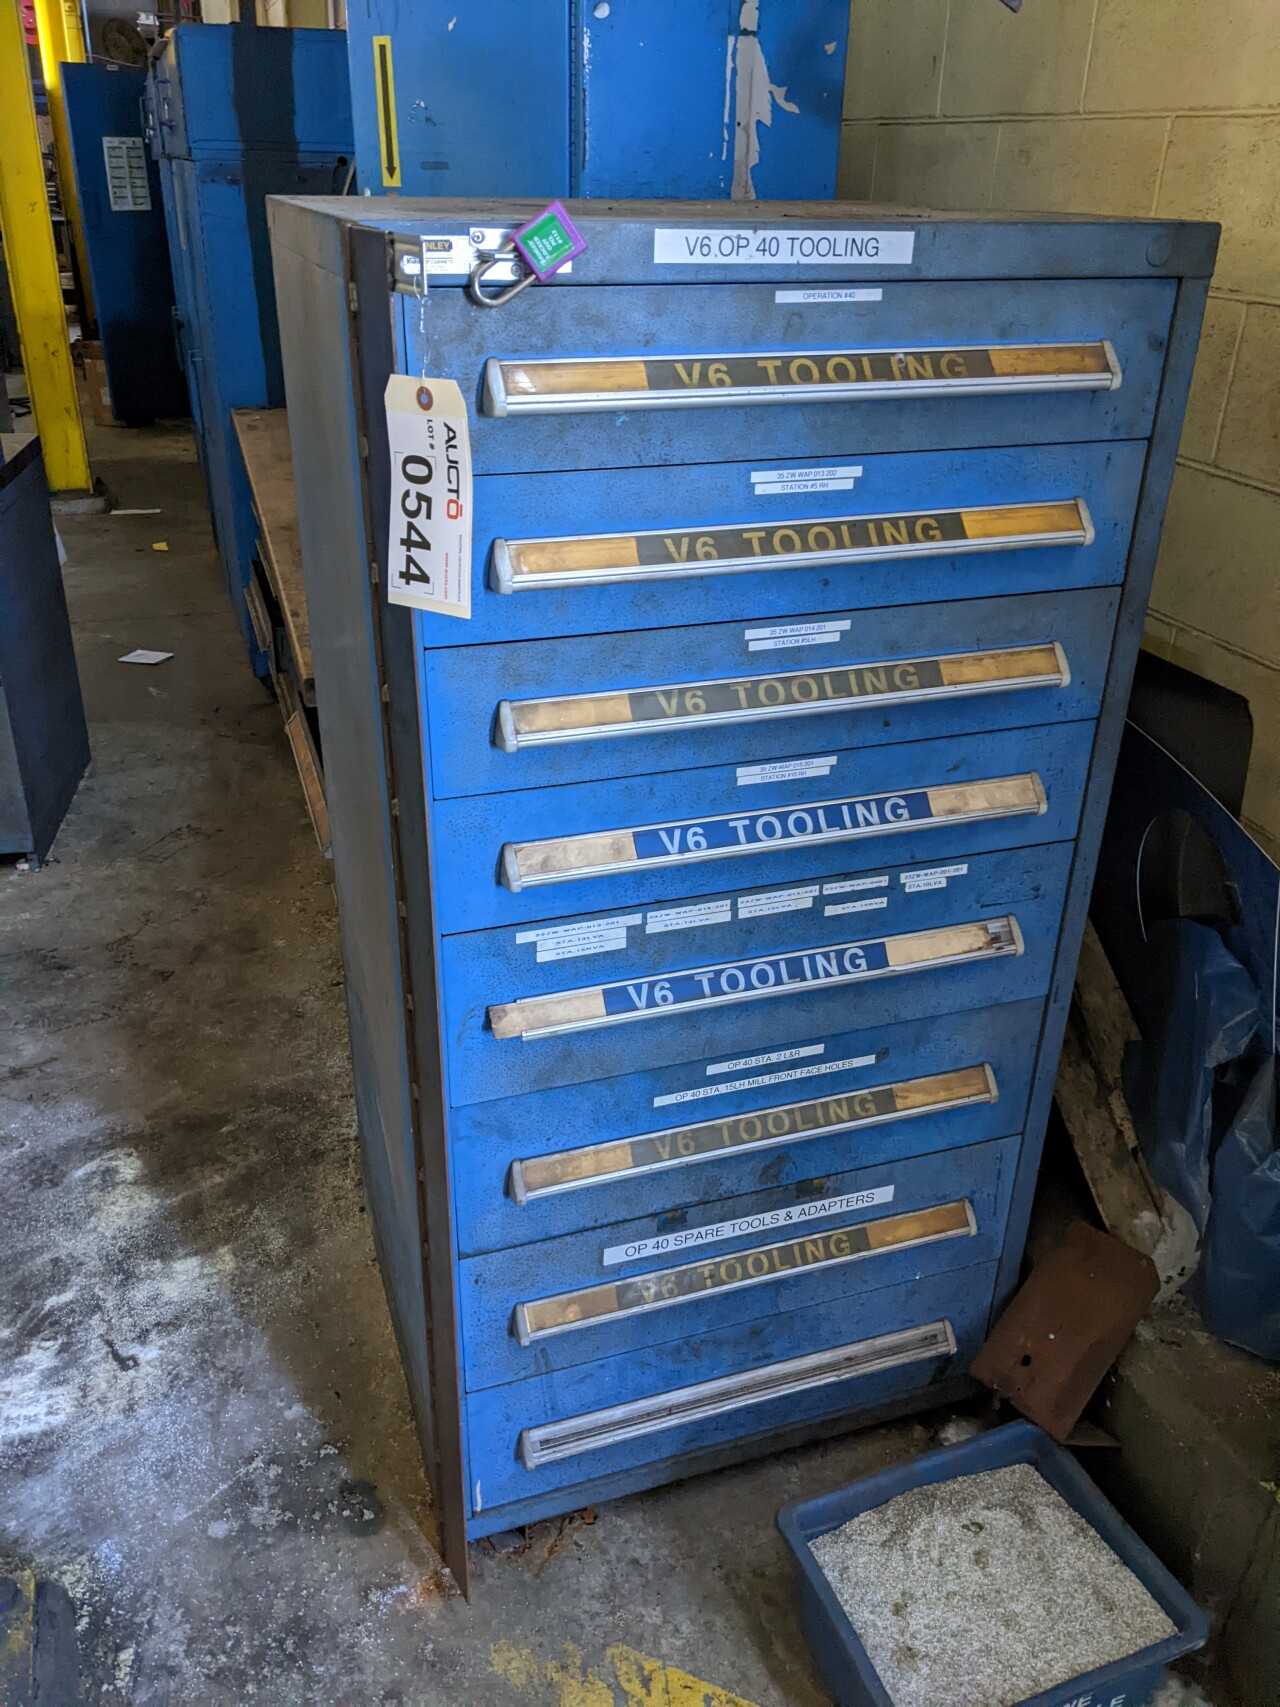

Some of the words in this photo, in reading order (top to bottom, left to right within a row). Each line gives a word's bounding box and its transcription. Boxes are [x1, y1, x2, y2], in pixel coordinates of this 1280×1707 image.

[756, 237, 779, 257] 40
[786, 237, 880, 257] TOOLING
[802, 292, 842, 300] OPERATION
[674, 361, 733, 388] V6
[756, 352, 969, 386] TOOLING
[426, 419, 435, 443] LOT
[798, 470, 813, 479] WAP
[398, 454, 434, 586] 0544
[664, 536, 719, 563] V6
[742, 516, 943, 557] TOOLING
[774, 638, 800, 647] STATION
[656, 688, 707, 716] V6
[729, 664, 921, 710] TOOLING
[658, 826, 708, 855] V6
[729, 796, 911, 845] TOOLING
[626, 981, 674, 1010] V6
[693, 947, 868, 998] TOOLING
[674, 1093, 689, 1102] OP
[690, 1089, 702, 1098] 40
[747, 1077, 767, 1087] MILL
[768, 1071, 798, 1084] FRONT
[799, 1065, 823, 1077] FACE
[824, 1060, 854, 1072] HOLES
[727, 1061, 742, 1070] OP
[742, 1059, 754, 1068] 40
[654, 1131, 696, 1160] V6
[714, 1092, 878, 1147] TOOLING
[624, 1243, 649, 1258] OP
[651, 1238, 670, 1252] 40
[673, 1226, 725, 1247] SPARE
[730, 1213, 780, 1234] TOOLS
[783, 1209, 793, 1221] &
[798, 1191, 876, 1218] ADAPTERS
[699, 1231, 850, 1289] TOOLING
